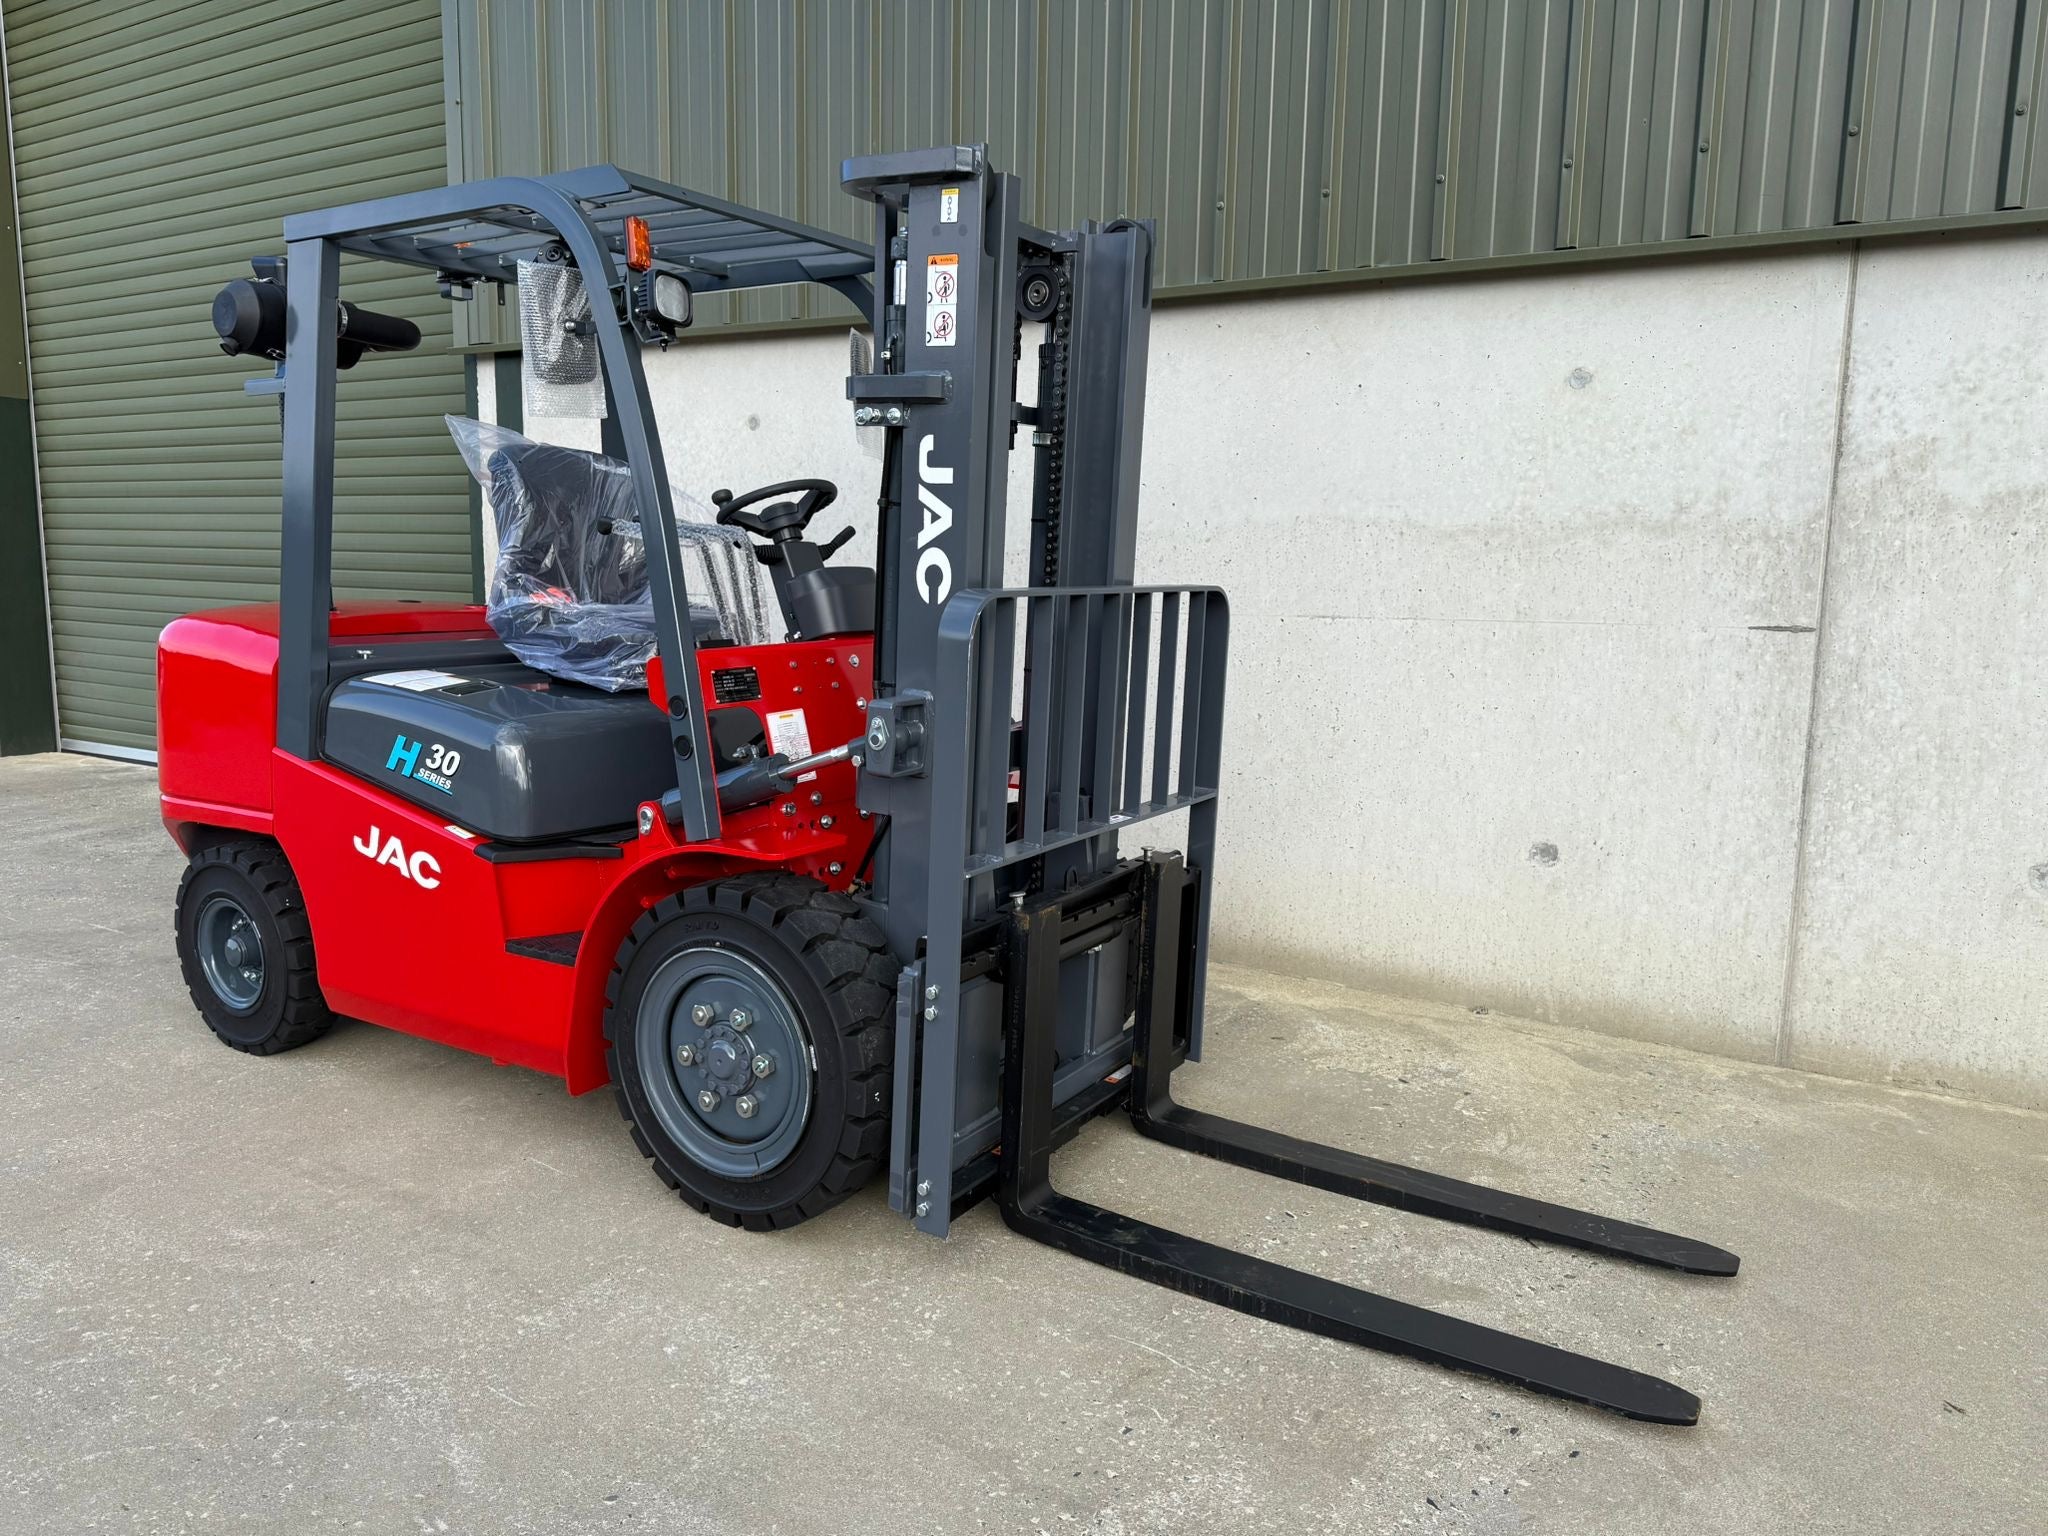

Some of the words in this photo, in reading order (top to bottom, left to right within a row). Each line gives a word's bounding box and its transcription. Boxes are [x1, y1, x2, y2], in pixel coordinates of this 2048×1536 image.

[916, 434, 954, 605] JAC
[385, 734, 423, 778] H
[425, 743, 461, 777] 30
[417, 767, 453, 790] SERIES
[353, 824, 442, 889] JAC
